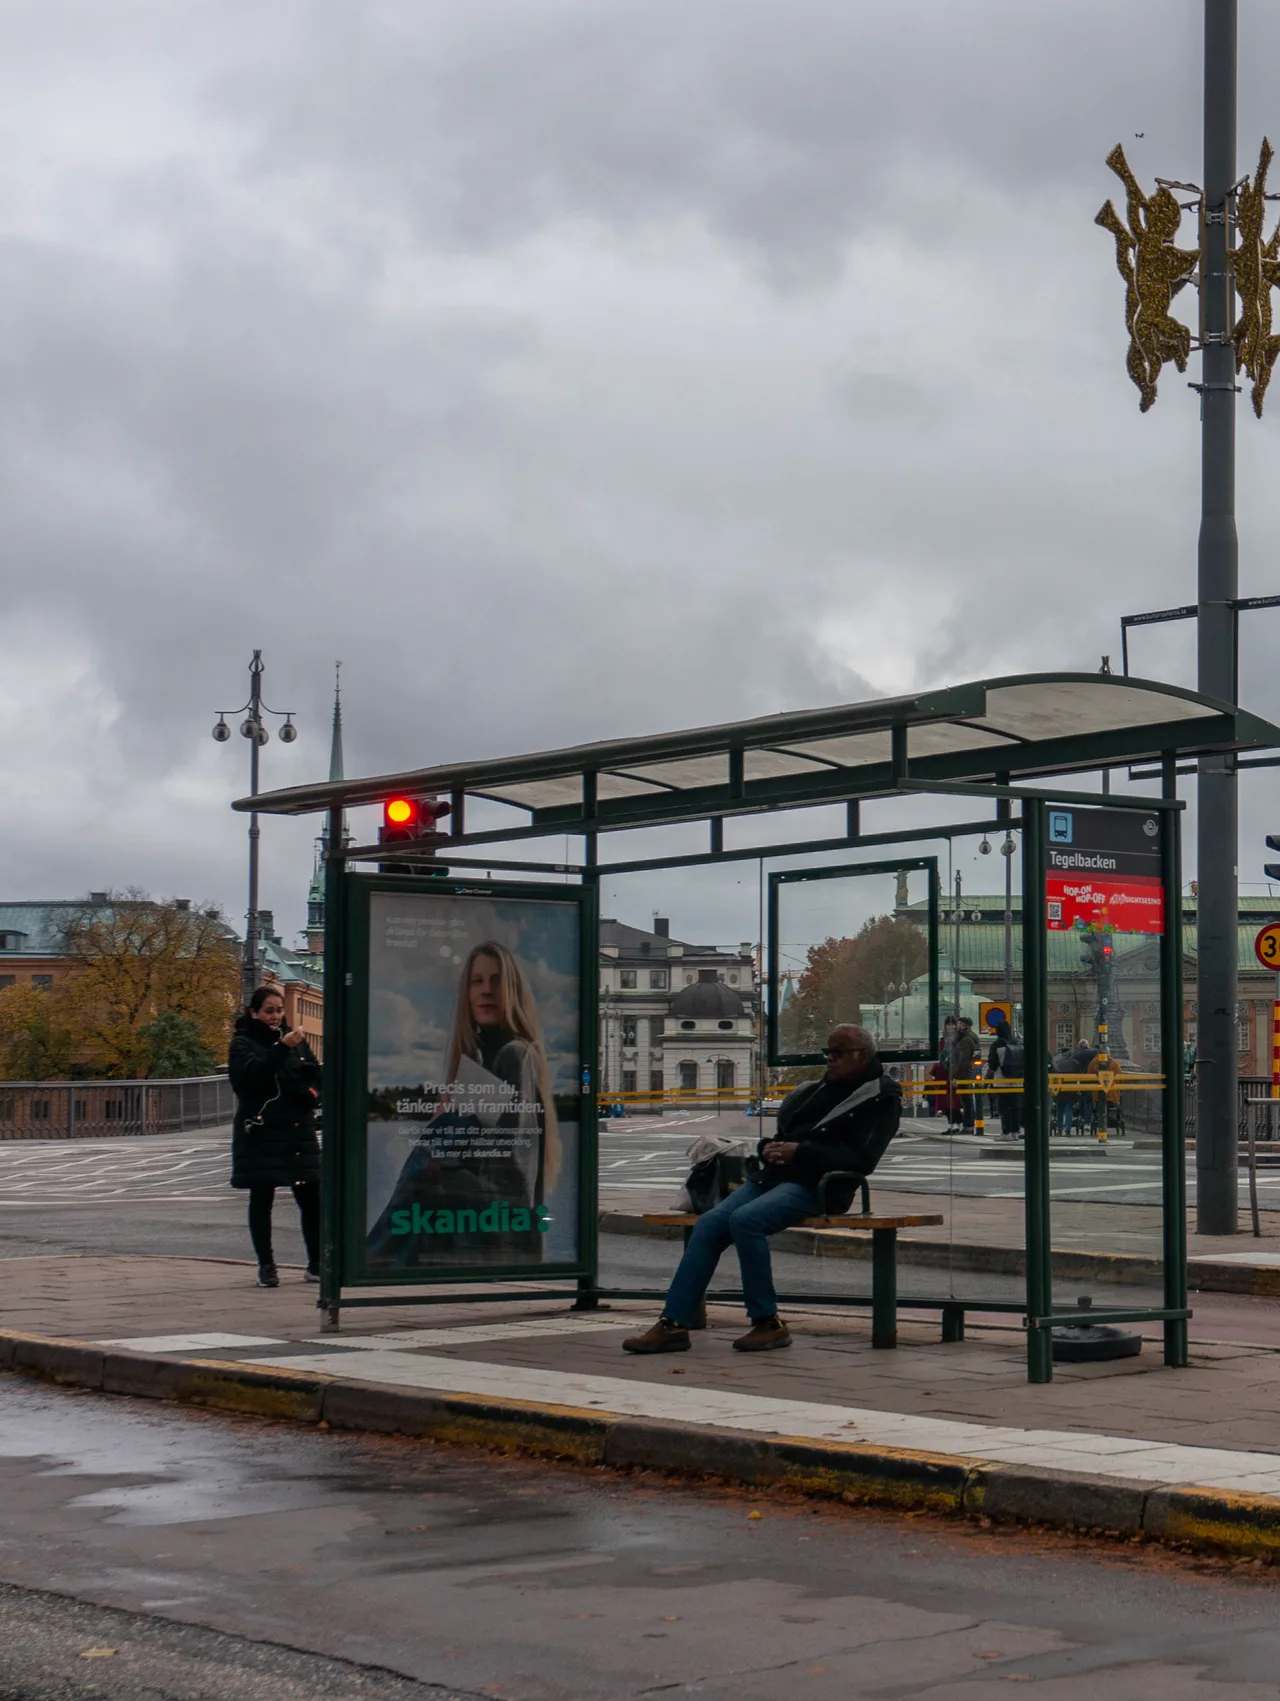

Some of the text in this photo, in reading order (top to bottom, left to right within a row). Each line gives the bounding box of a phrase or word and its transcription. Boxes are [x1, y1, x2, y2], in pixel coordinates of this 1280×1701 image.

[1050, 851, 1116, 869] Tegelbacken
[1063, 885, 1092, 896] HOP-ON
[1076, 892, 1105, 904] HOP-OFF
[424, 1080, 519, 1097] Precis som du,
[396, 1099, 545, 1116] tänker vi på framtiden.
[398, 1126, 420, 1135] Därför
[435, 1126, 442, 1134] vi
[444, 1126, 453, 1135] till
[455, 1127, 465, 1135] att
[467, 1126, 479, 1135] ditt
[481, 1126, 543, 1137] pensionssparande
[432, 1138, 442, 1146] till
[443, 1139, 453, 1147] en
[454, 1139, 469, 1147] mer
[470, 1137, 495, 1147] hållbar
[431, 1149, 445, 1158] Läs
[462, 1149, 472, 1159] på
[473, 1149, 511, 1158] skandia.se
